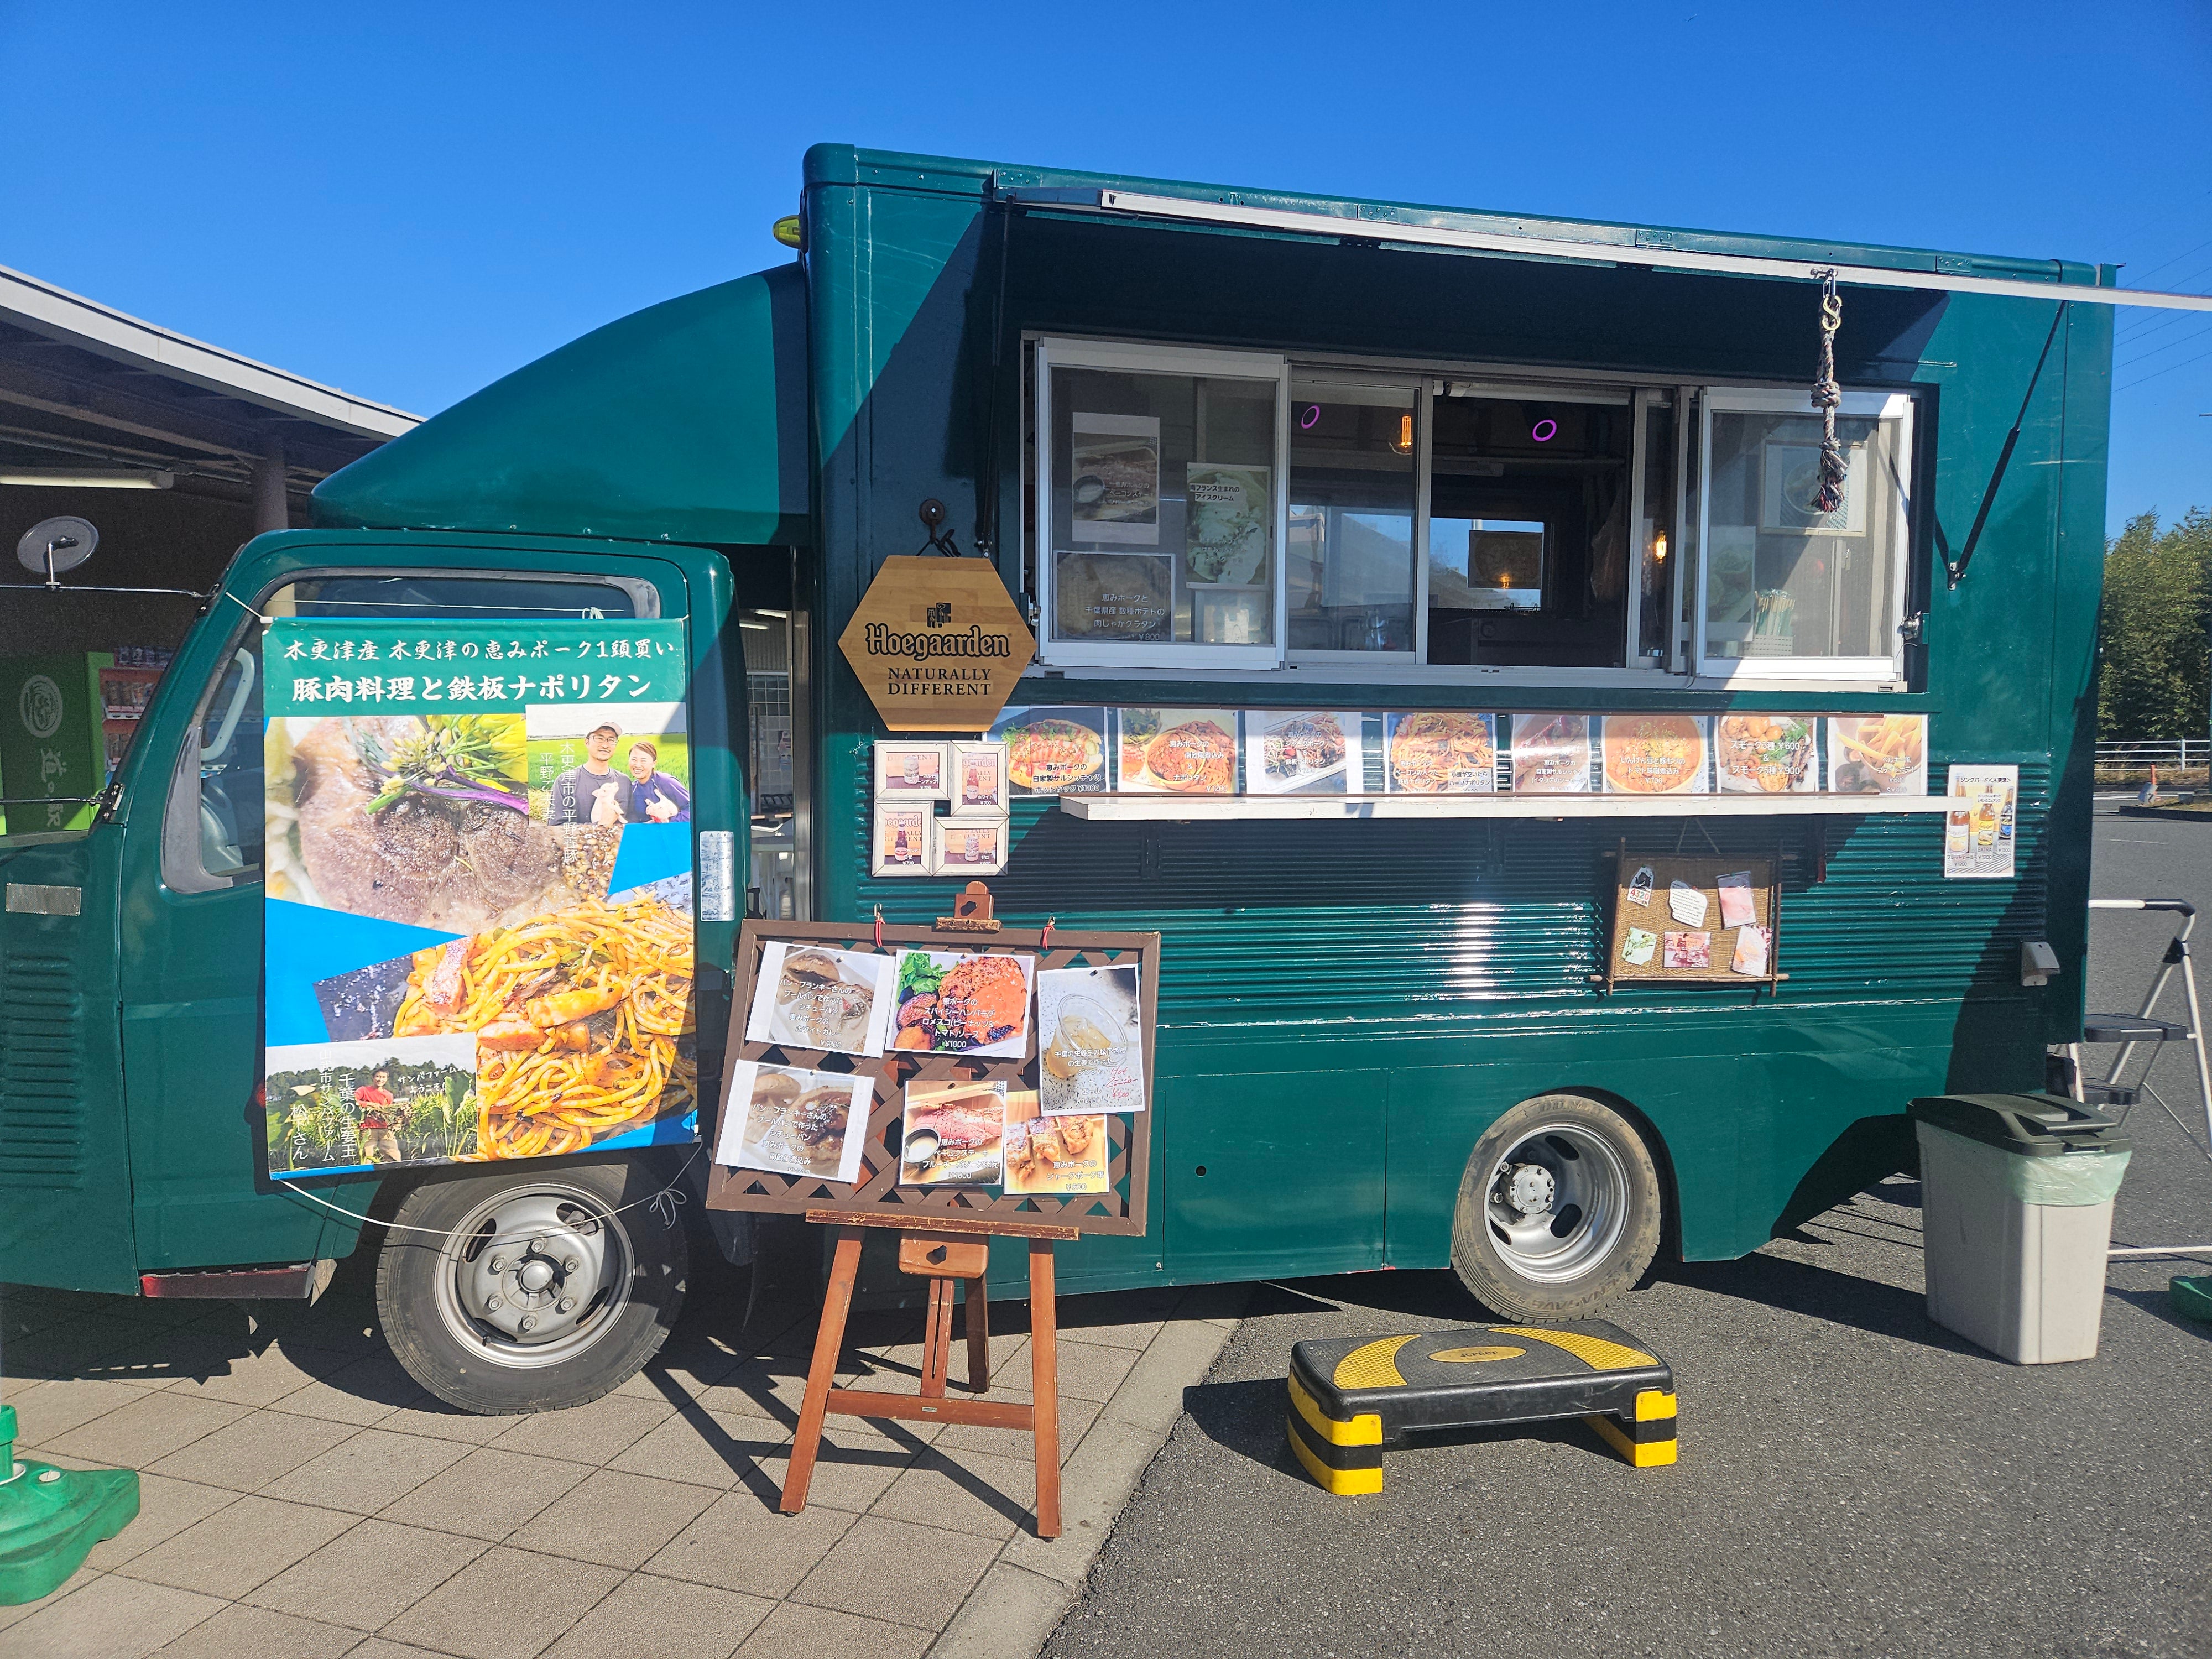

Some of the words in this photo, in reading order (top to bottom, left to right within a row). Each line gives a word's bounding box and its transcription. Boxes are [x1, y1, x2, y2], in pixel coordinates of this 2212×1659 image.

[1102, 593, 1148, 602] 恵みポークと
[1085, 606, 1117, 615] 千葉県産
[864, 623, 1010, 661] Hoegaarden
[1139, 633, 1160, 641] ¥800
[284, 639, 380, 661] 木更津産
[389, 638, 674, 661] 木更津の恵みポーク1頭買い
[888, 667, 992, 681] NATURALLY
[292, 674, 651, 703] 豚肉料理と鉄板ナポリタン
[888, 683, 992, 696] DIFFERENT
[1730, 740, 1775, 750] スモーク3種
[1778, 742, 1800, 750] ¥600
[1732, 765, 1777, 775] スモーク5種
[1778, 766, 1800, 775] ¥900
[539, 753, 556, 821] 平野ご夫妻
[1078, 784, 1100, 792] ¥1000
[560, 741, 578, 863] 木更津市の平野養豚
[1630, 888, 1650, 900] 4320
[943, 998, 978, 1006] 恵ポークの
[924, 1008, 995, 1017] スパイシーハンバーグ
[789, 1013, 829, 1025] 恵みポークの
[795, 1025, 842, 1036] ホワイトカレー
[935, 1029, 979, 1039] トマト)ソース
[1055, 1047, 1126, 1058] 千葉の生姜王の松下さん
[1068, 1058, 1113, 1067] の生姜で作った
[398, 1066, 466, 1084] サンバファームへ
[1111, 1066, 1128, 1077] Hot
[319, 1050, 335, 1162] 山武市サンバファーム
[338, 1072, 357, 1159] 千葉の生姜王
[290, 1104, 310, 1161] 松下さん
[769, 1129, 811, 1141] シチューパン
[763, 1140, 804, 1152] 恵みポークの
[941, 1138, 982, 1146] 恵みポークの
[1053, 1160, 1097, 1169] 恵みポークの
[1066, 1183, 1087, 1191] ¥600
